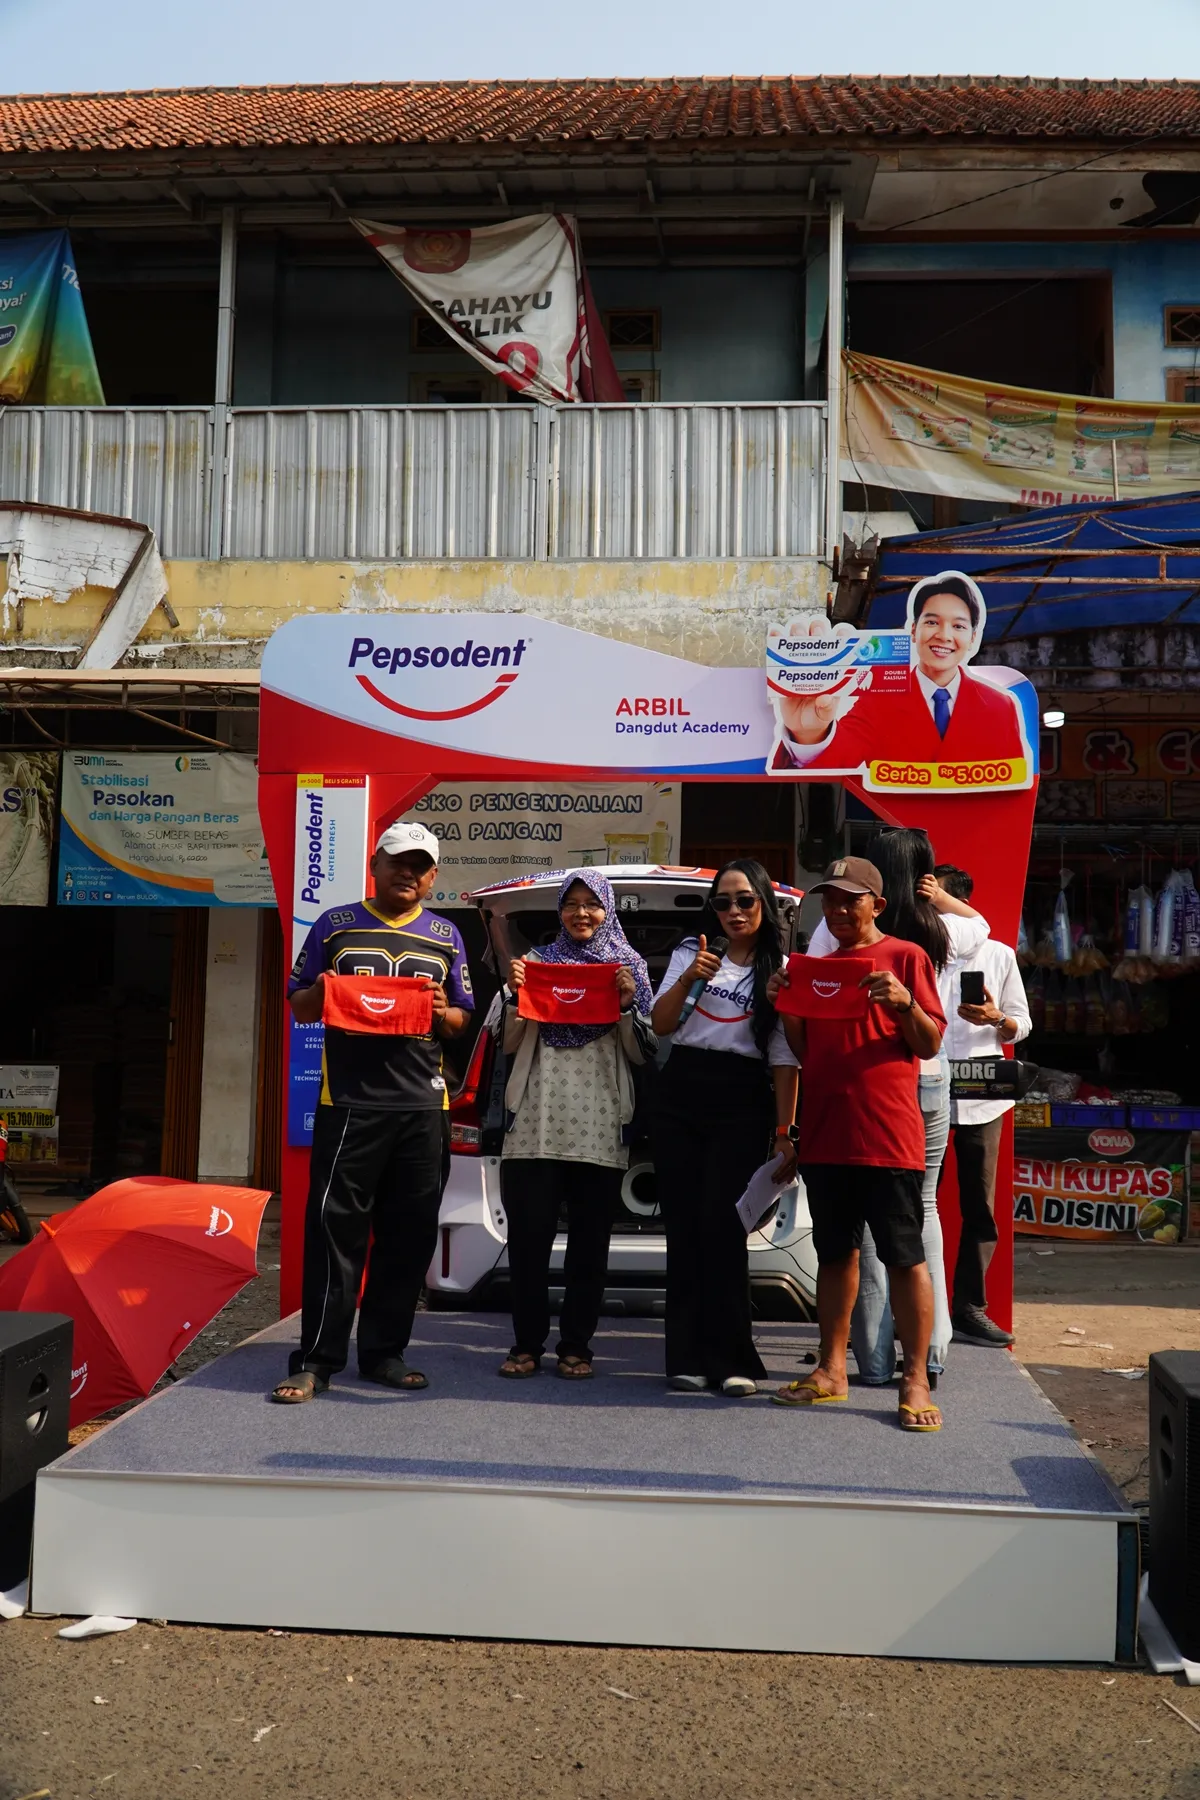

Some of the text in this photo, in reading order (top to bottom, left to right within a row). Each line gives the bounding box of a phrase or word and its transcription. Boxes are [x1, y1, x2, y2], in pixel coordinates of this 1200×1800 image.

[1017, 488, 1063, 507] JADI
[777, 637, 840, 652] Pepsodent
[348, 637, 526, 675] Pepsodent
[777, 669, 840, 683] Pepsodent
[615, 697, 691, 716] ARBIL
[615, 721, 750, 735] Dangdut Academy
[81, 773, 149, 787] Stabilisasi
[877, 764, 1010, 783] Serba Rp 5.000
[0, 787, 37, 812] S”
[93, 789, 175, 807] Pasokan
[408, 792, 643, 813] SKO PENGENDALIAN
[88, 810, 239, 825] dan Harga Pangan Beras
[120, 829, 141, 839] Toko
[146, 829, 229, 841] SUMBER BERAS
[427, 821, 562, 841] GA PANGAN
[124, 841, 156, 850] Alamat
[187, 843, 210, 851] BARU
[301, 792, 325, 904] Pepsodent
[128, 853, 155, 862] Harga
[328, 848, 336, 882] CENTER
[442, 854, 553, 867] dan Tahun Baru (NATARU)
[619, 854, 641, 863] SPHP
[328, 911, 356, 927] 99
[430, 920, 453, 938] 99
[552, 986, 587, 994] Pepsodent
[812, 978, 842, 988] Pepsodent
[360, 993, 396, 1005] Pepsodent
[950, 1062, 996, 1079] KORG
[1061, 1164, 1174, 1199] KUPAS
[1012, 1194, 1139, 1232] A DISINI
